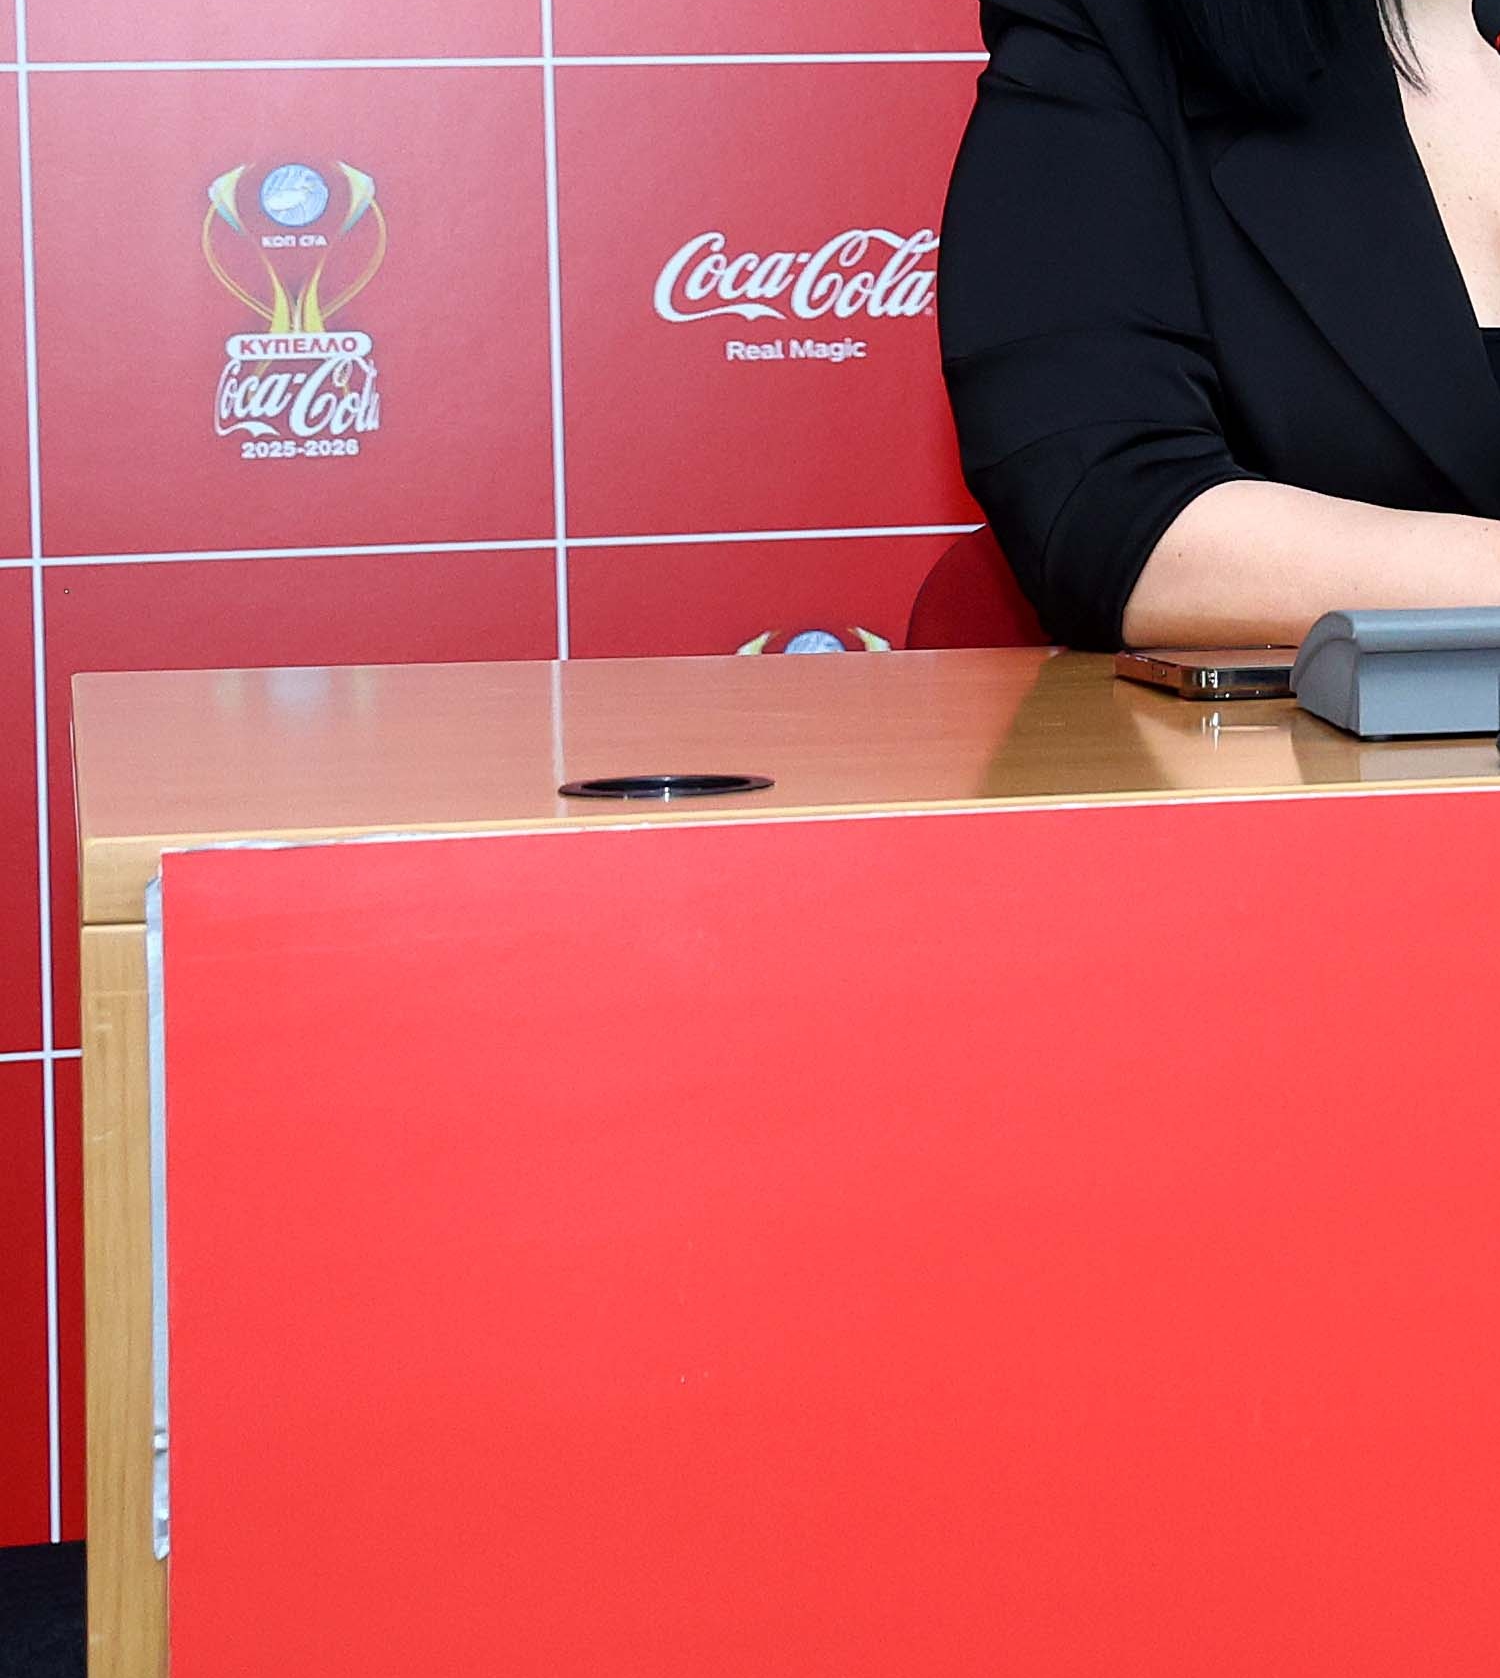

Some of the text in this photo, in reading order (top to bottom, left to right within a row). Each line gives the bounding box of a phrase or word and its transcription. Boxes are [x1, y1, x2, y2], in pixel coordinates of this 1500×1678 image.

[653, 228, 940, 322] Coca-Cola
[239, 336, 357, 355] ΚΥΠΕΛΛΟ
[726, 337, 866, 362] Real Magic
[241, 438, 359, 458] 2025-2026
